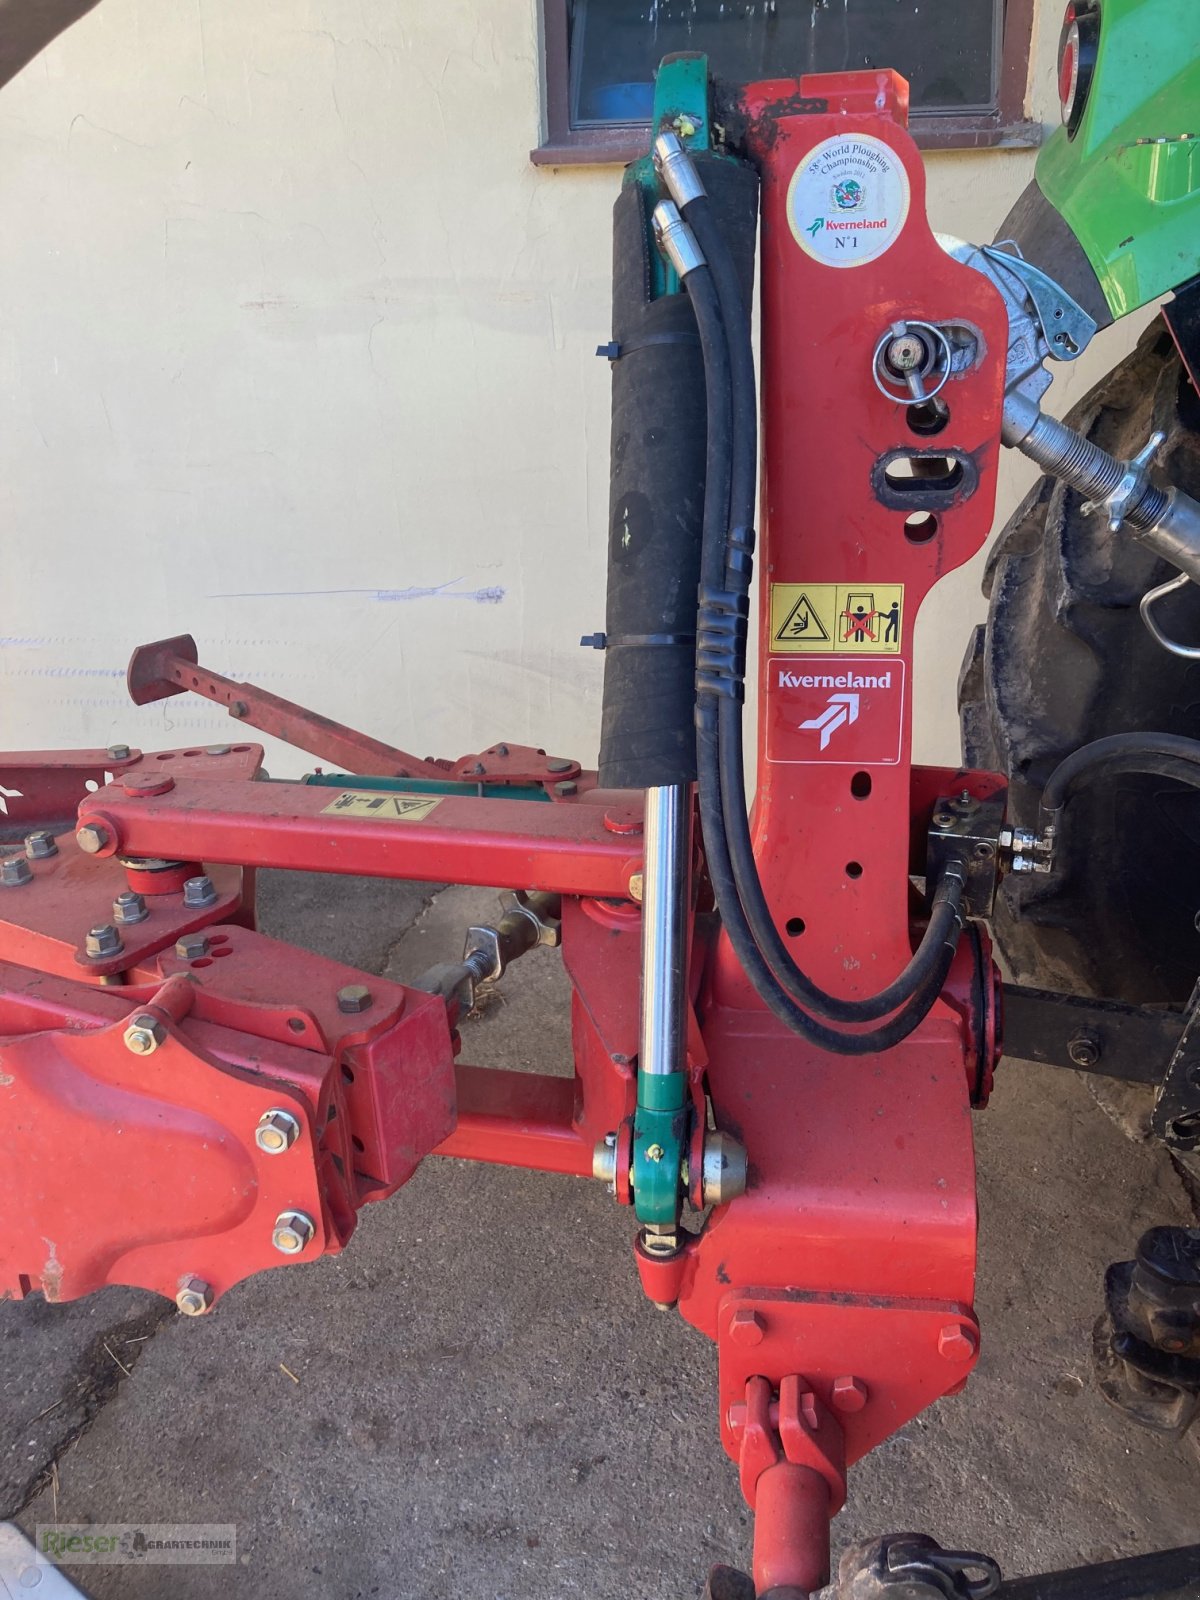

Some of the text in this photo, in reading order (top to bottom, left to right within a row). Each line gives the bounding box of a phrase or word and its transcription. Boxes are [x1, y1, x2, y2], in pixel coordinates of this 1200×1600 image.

[821, 155, 877, 175] Championship
[823, 144, 850, 161] World
[852, 144, 890, 173] Ploughing
[826, 218, 887, 230] Kverneland
[778, 670, 891, 688] Kverneland
